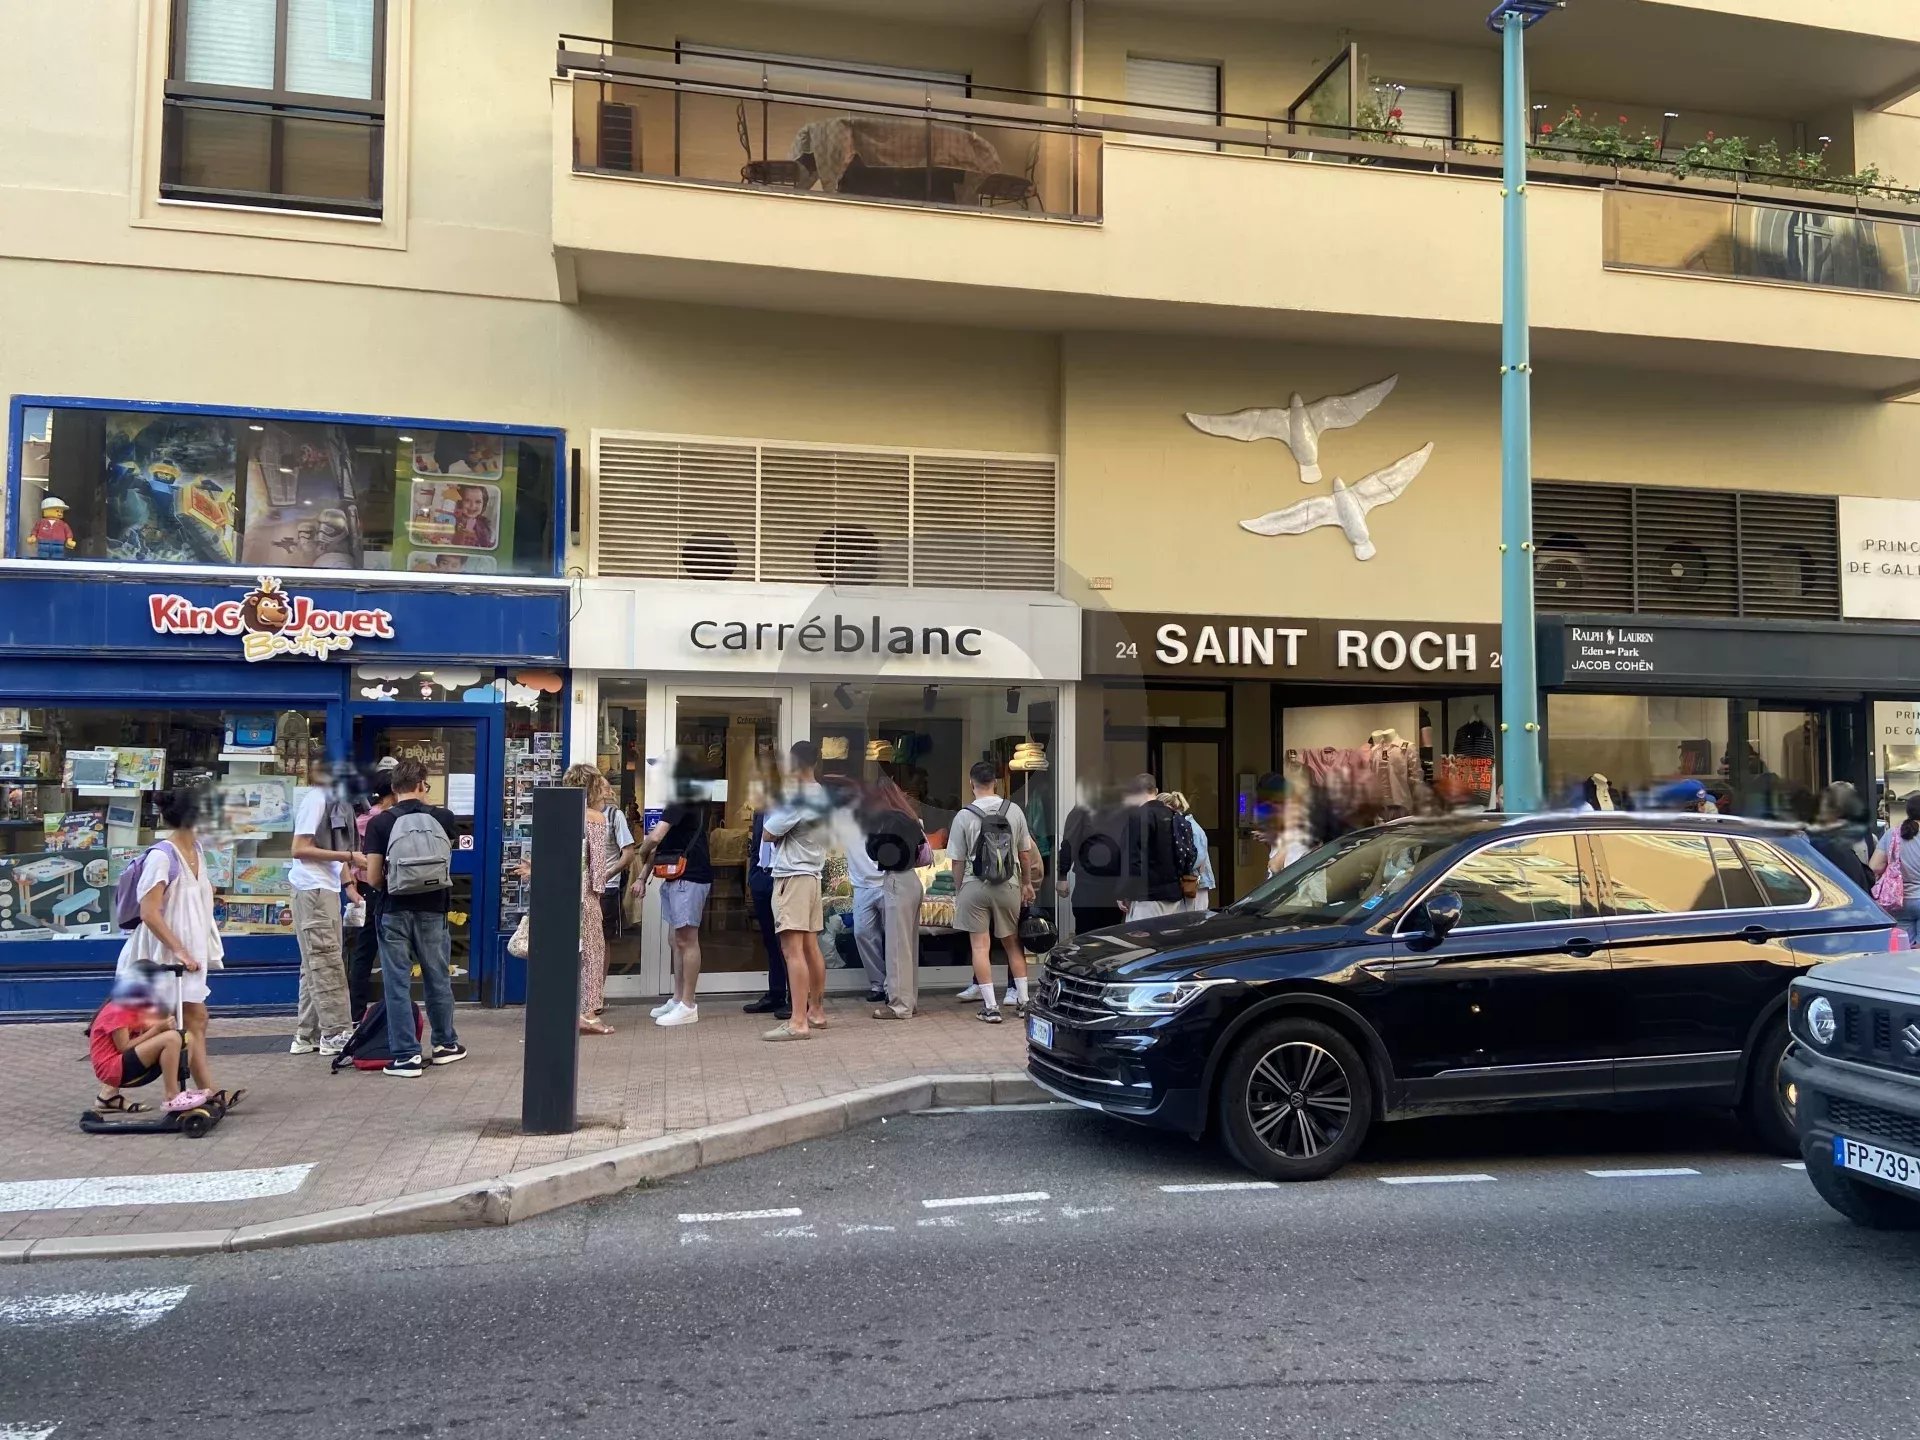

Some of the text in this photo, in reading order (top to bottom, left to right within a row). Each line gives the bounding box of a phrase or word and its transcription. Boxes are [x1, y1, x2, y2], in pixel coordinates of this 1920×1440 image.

[1849, 562, 1920, 577] DE GAL
[286, 598, 391, 634] Jouet
[691, 614, 983, 657] carréblanc
[1572, 627, 1654, 643] RALPH LAUREN
[244, 629, 351, 659] Boutique
[1116, 623, 1503, 671] 24 SAINT ROCH 2
[1581, 646, 1640, 657] Eden Park
[1571, 660, 1611, 670] JACOB
[1885, 726, 1900, 735] DE
